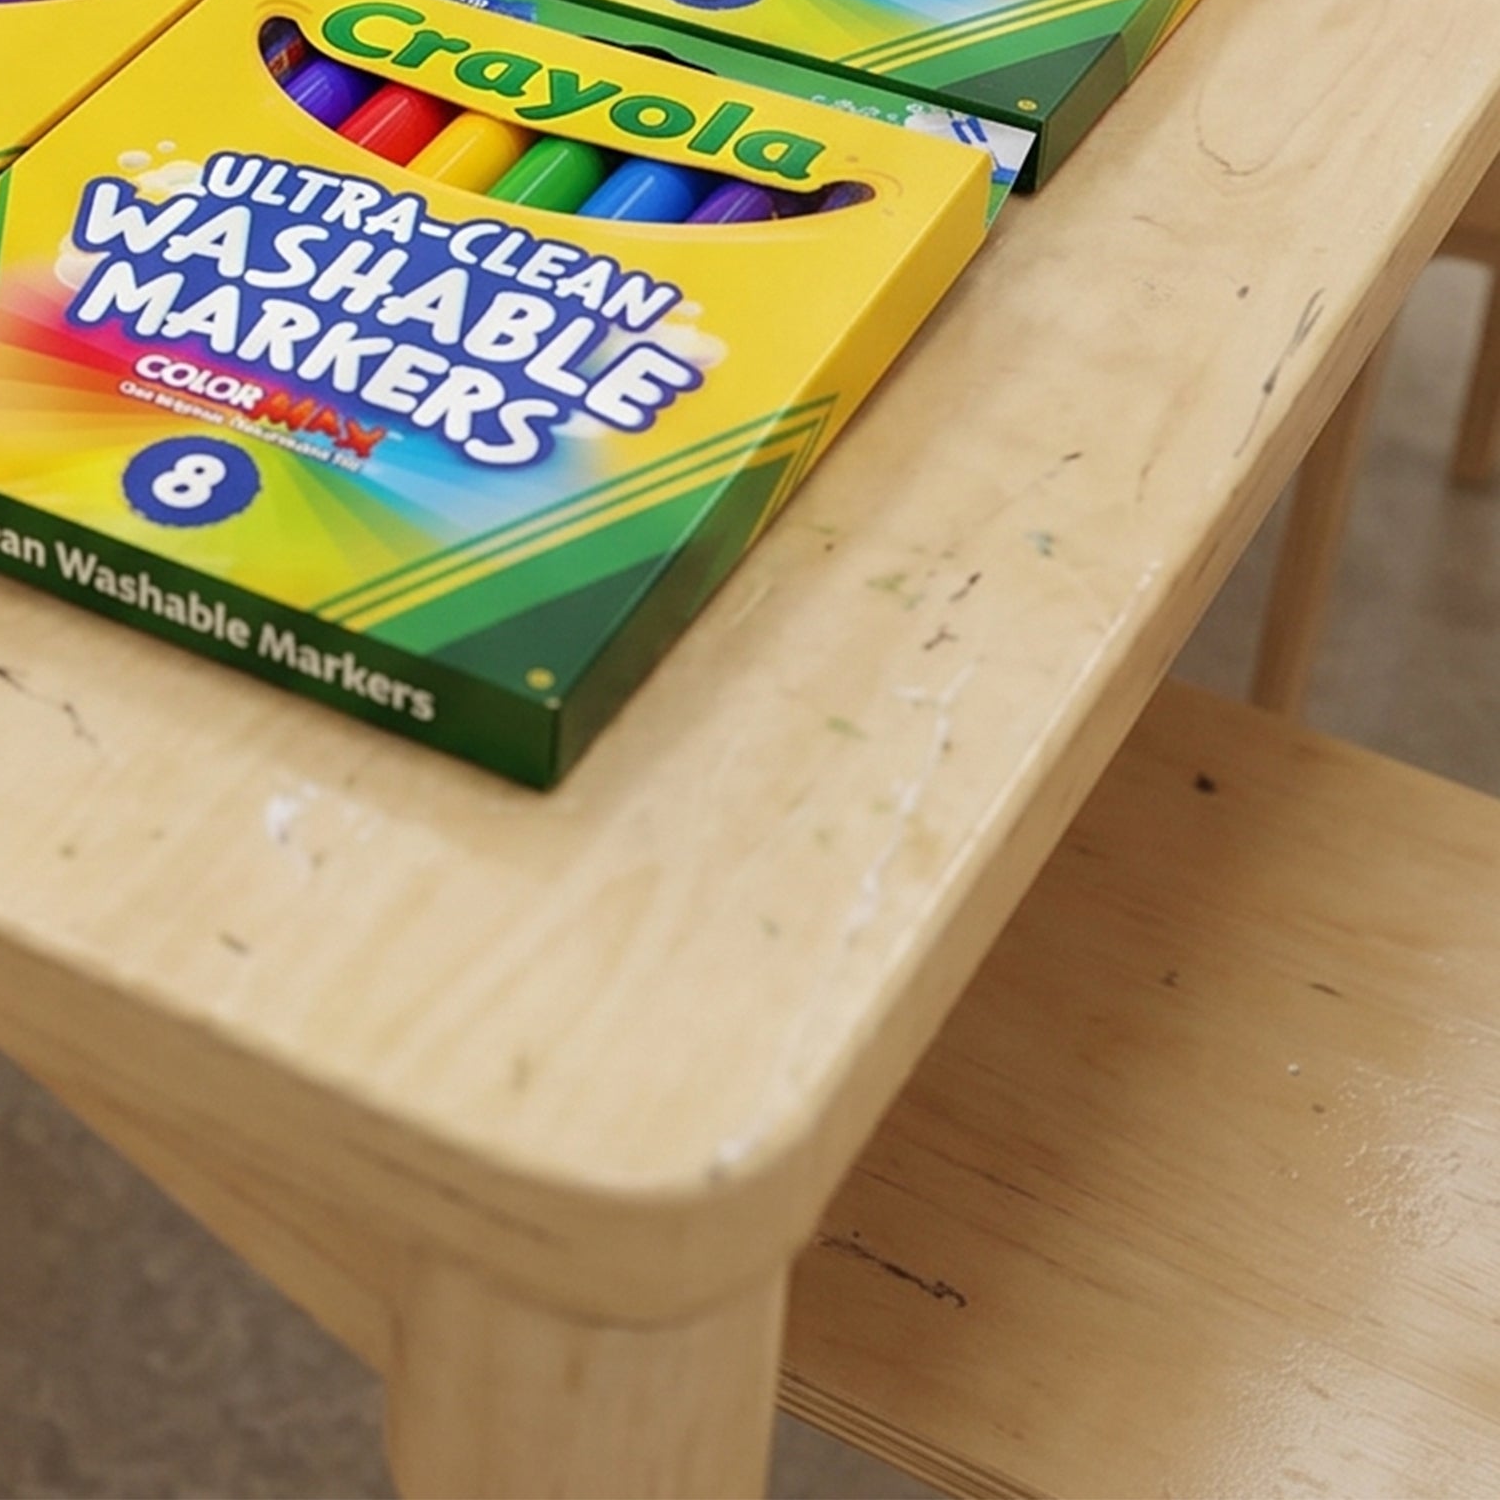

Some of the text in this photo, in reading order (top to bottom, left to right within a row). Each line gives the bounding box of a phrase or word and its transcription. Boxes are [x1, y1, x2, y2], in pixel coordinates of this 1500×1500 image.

[321, 2, 828, 182] Crayola
[84, 182, 692, 427] WASHABLE
[207, 154, 674, 329] ULTRA-CLEAN
[79, 262, 558, 464] MARKERS
[135, 354, 264, 410] COLOR
[252, 390, 386, 458] MAX
[151, 454, 227, 509] 8
[56, 542, 251, 648] Washable
[258, 623, 436, 722] Markers
